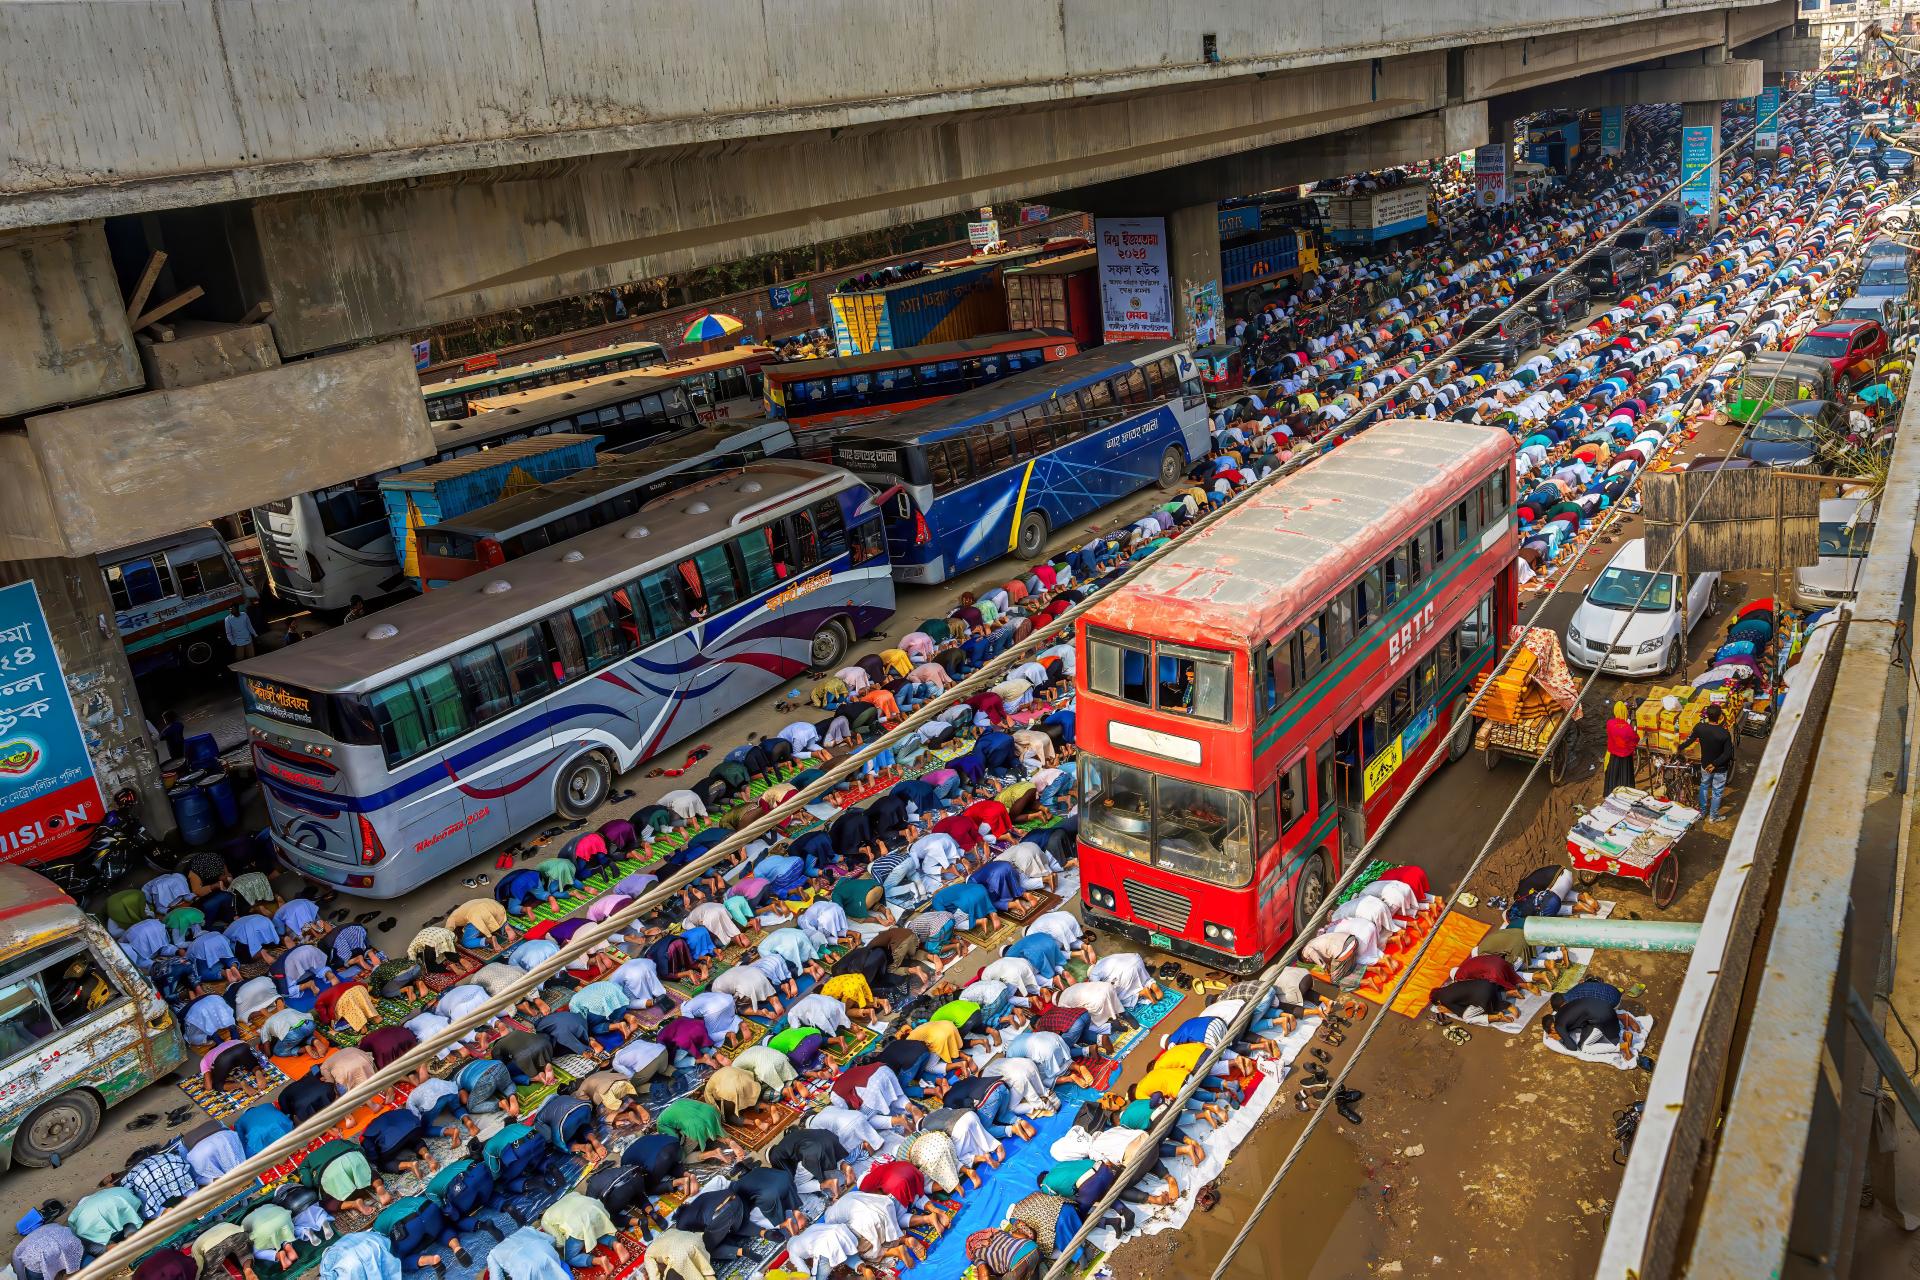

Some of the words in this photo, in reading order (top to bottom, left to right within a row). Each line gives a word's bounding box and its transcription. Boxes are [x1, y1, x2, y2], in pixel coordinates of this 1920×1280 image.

[1118, 248, 1147, 260] ২০২৪
[1107, 264, 1132, 277] সফল
[1136, 263, 1160, 277] হউক
[1389, 601, 1435, 666] BRTC
